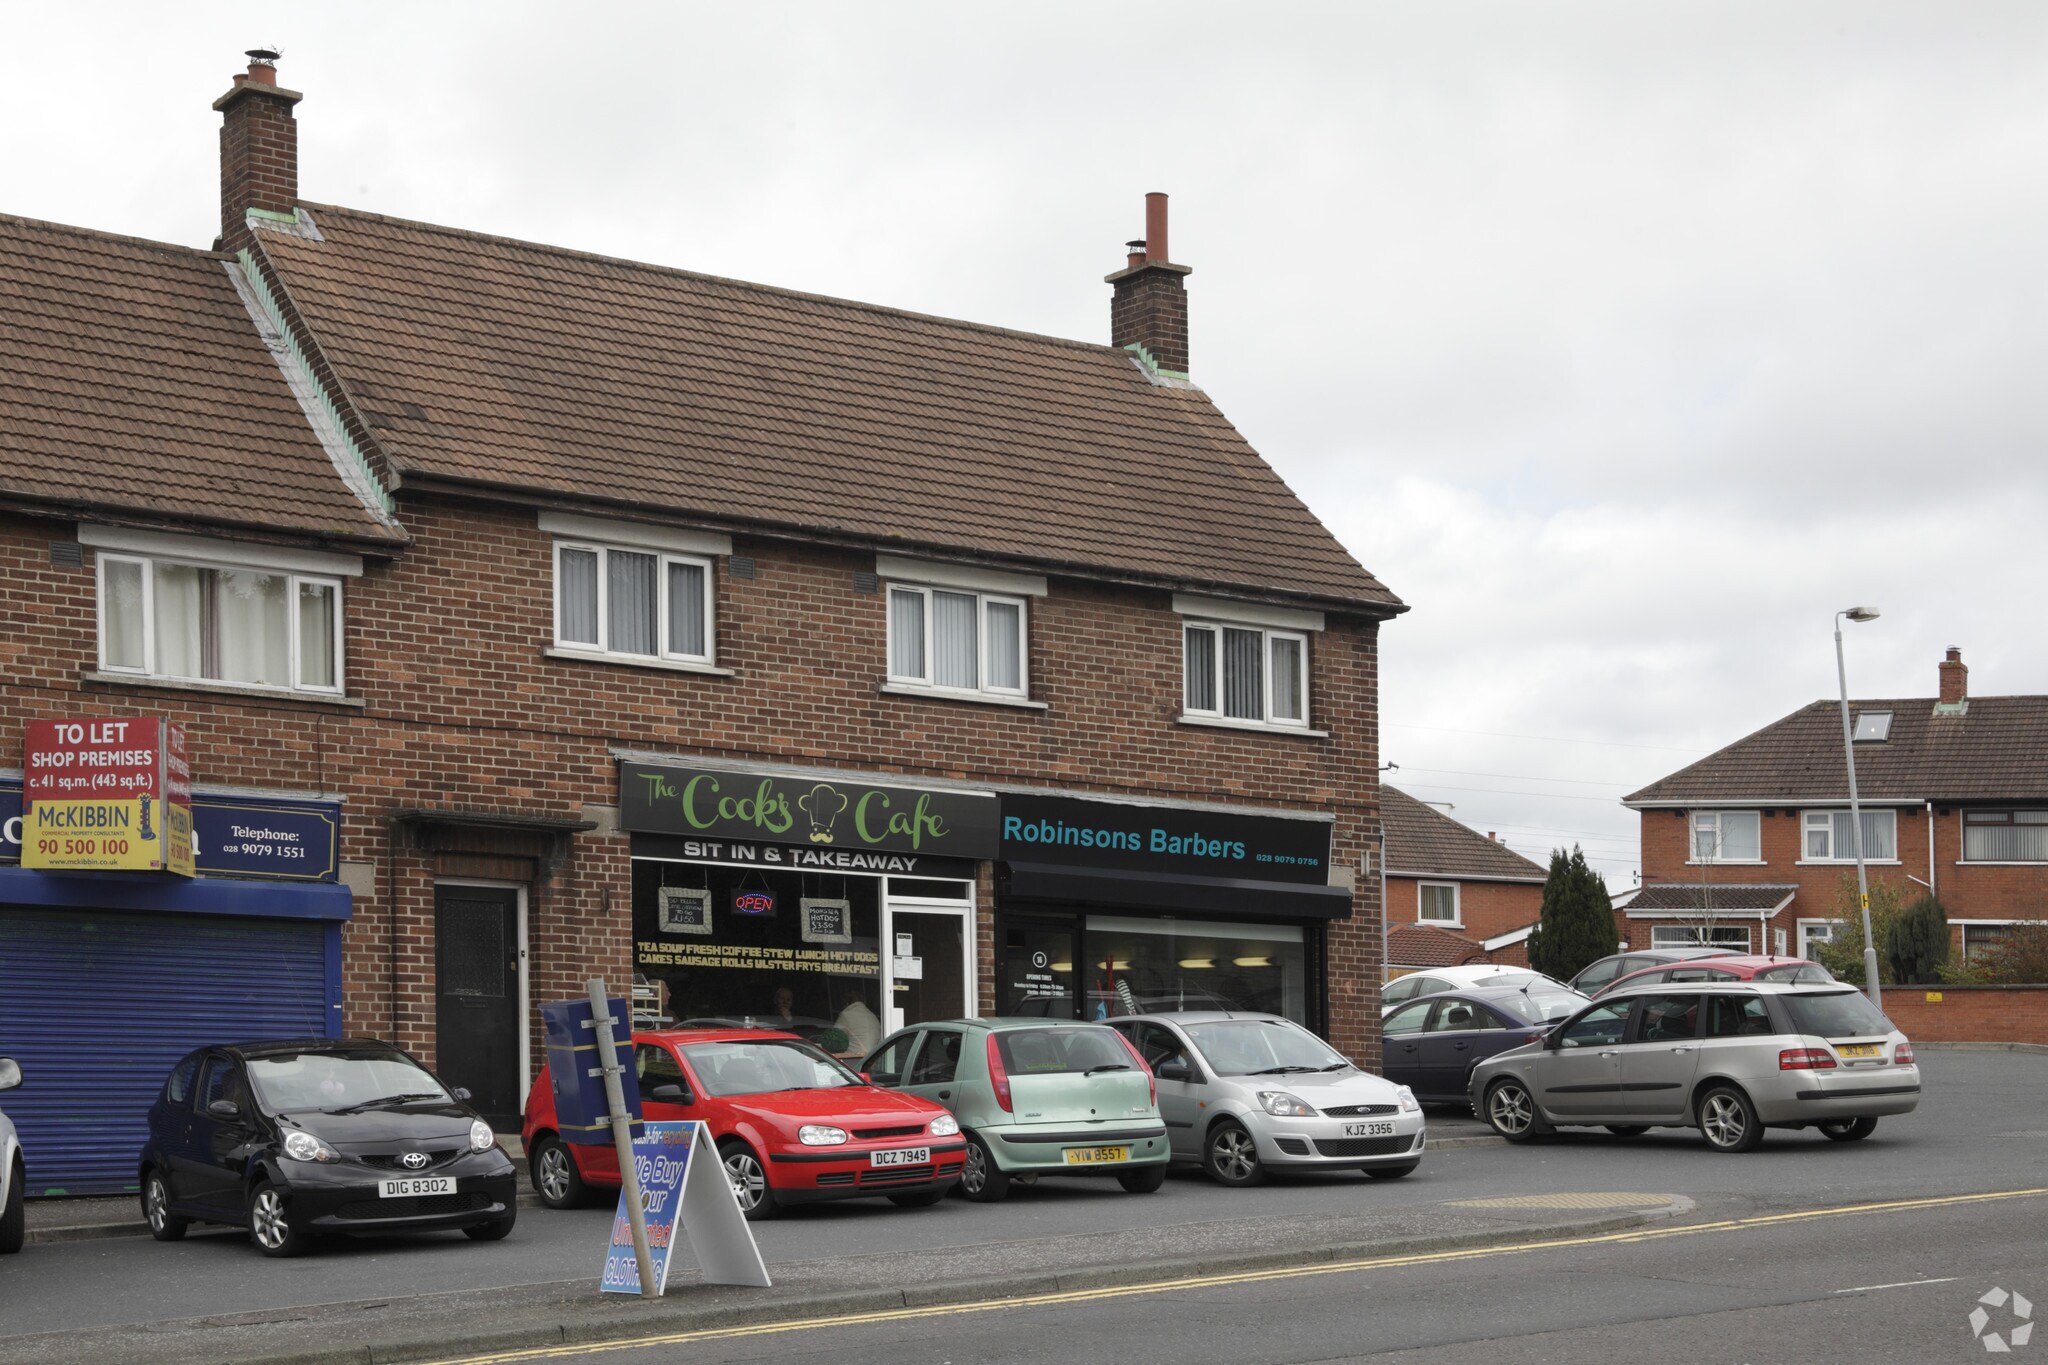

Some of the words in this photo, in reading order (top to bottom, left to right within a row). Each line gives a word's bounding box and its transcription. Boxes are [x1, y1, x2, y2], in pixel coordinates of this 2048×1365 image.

[54, 723, 84, 745] TO
[90, 722, 129, 744] LET
[31, 751, 75, 767] SHOP
[79, 749, 153, 767] PREMISES
[41, 774, 54, 788] 41
[58, 776, 90, 791] sq.m.
[91, 773, 117, 791] (443
[119, 772, 153, 791] sq.ft.)
[38, 805, 129, 828] McKIBBIN
[636, 773, 680, 807] The
[854, 790, 950, 850] Cafe
[231, 825, 300, 842] Telephone:
[1003, 815, 1142, 851] Robinsons
[1150, 828, 1246, 860] Barbers
[38, 839, 58, 855] 90
[65, 839, 96, 855] 500
[102, 839, 129, 855] 100
[223, 844, 239, 853] 028
[241, 843, 272, 856] 9079
[276, 845, 305, 858] 1551
[48, 858, 118, 866] www.mckibbin.co.uk
[684, 841, 722, 857] SIT
[731, 843, 755, 861] IN
[764, 845, 782, 862] &
[788, 848, 918, 872] TAKEAWAY
[1256, 853, 1272, 862] 028
[1274, 855, 1296, 864] 9079
[1297, 857, 1318, 866] 0756
[735, 896, 773, 911] OPEN
[638, 941, 658, 952] TEA
[658, 942, 686, 954] SOUP
[686, 944, 721, 955] FRESH
[722, 945, 762, 957] COFFEE
[763, 947, 794, 959] STEW
[795, 949, 829, 960] LUNCH
[830, 951, 853, 961] HOT
[854, 952, 878, 963] DOGS
[639, 953, 673, 965] CAKES
[674, 955, 721, 967] SAUSAGE
[722, 957, 754, 969] ROLLS
[754, 959, 795, 970] ULSTER
[795, 961, 820, 972] FRYS
[821, 963, 880, 975] BREAKFAST
[1345, 1124, 1366, 1136] KJZ
[1368, 1123, 1393, 1135] 3356
[875, 1151, 897, 1165] DCZ
[900, 1149, 927, 1162] 7949
[1073, 1150, 1091, 1162] YIW
[1094, 1148, 1121, 1160] 8557
[651, 1155, 684, 1190] Buy
[387, 1181, 408, 1195] DIG
[412, 1179, 448, 1193] 8302
